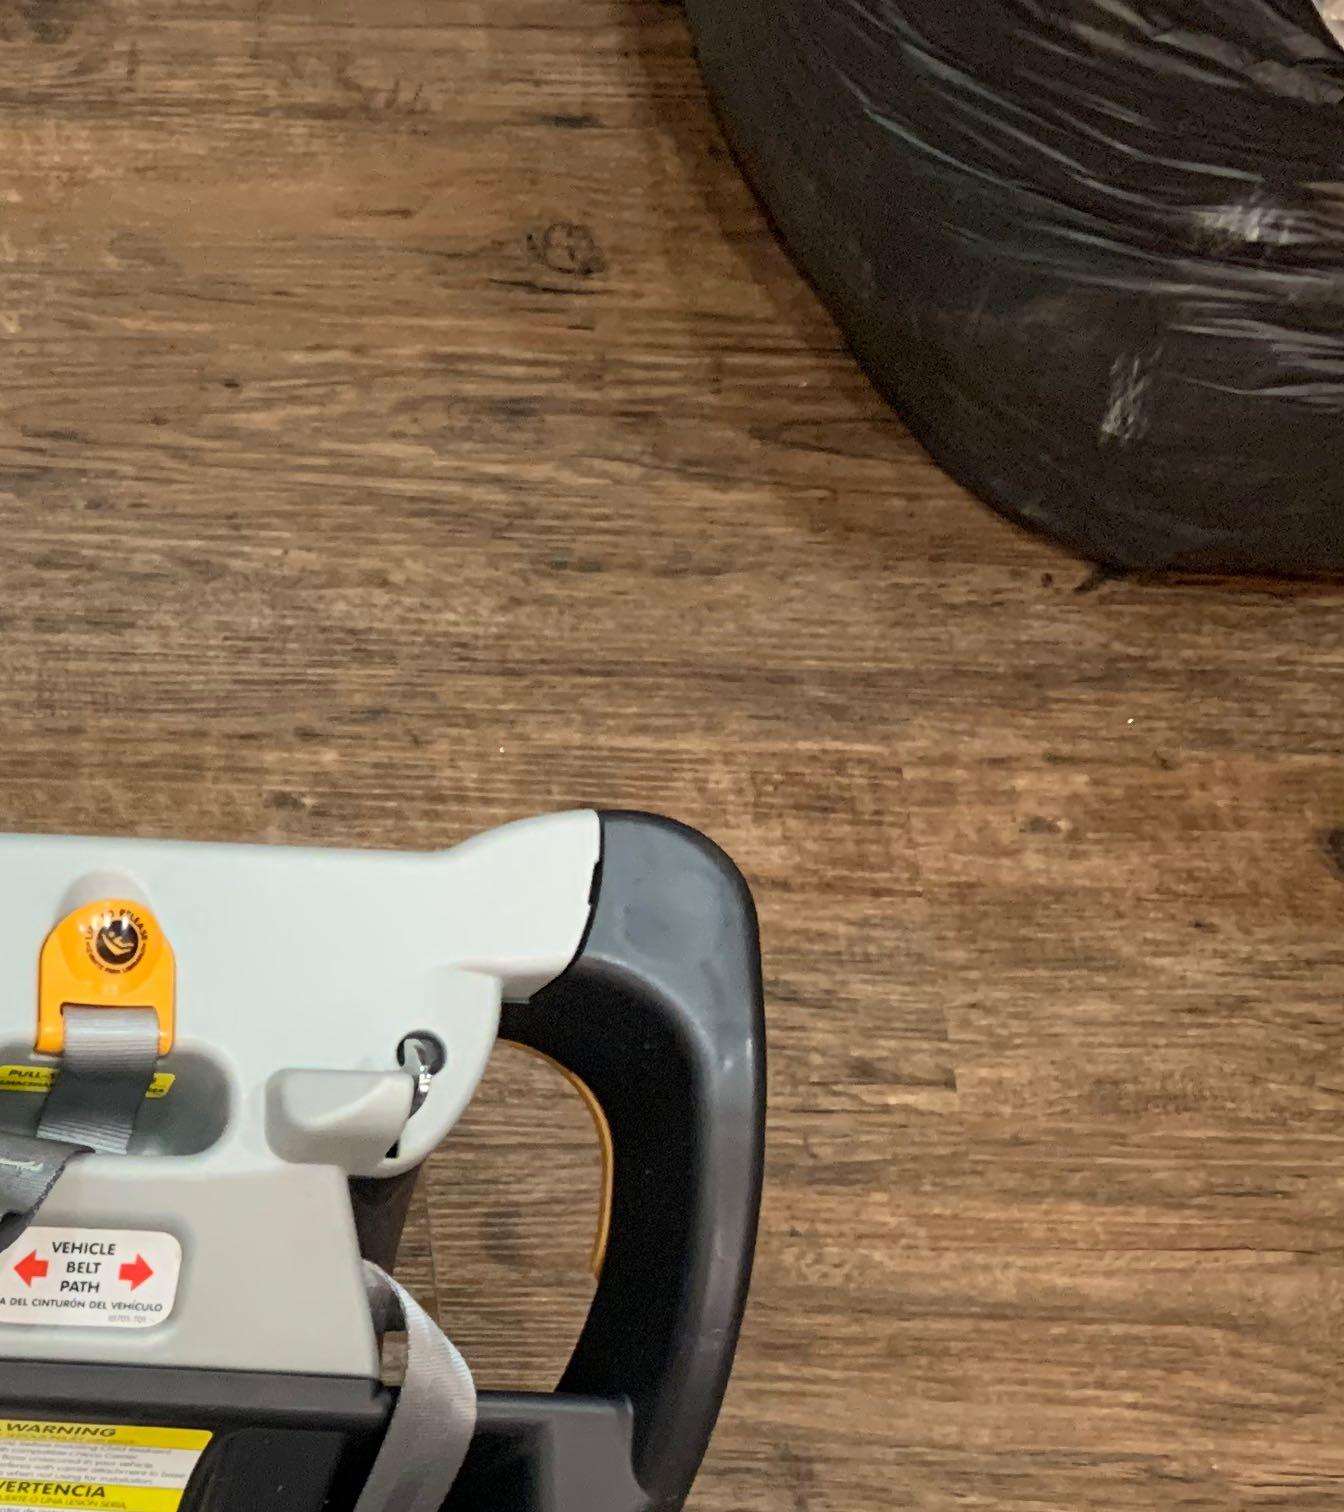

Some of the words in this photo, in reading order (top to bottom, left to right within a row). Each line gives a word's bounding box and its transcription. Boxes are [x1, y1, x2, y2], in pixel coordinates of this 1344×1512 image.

[52, 1241, 116, 1256] VEHICLE
[67, 1262, 101, 1274] BELT
[60, 1281, 100, 1293] PATH
[10, 1298, 28, 1306] DEL
[32, 1298, 85, 1308] CINTURÓN
[89, 1301, 106, 1310] DEL
[112, 1301, 162, 1312] VEHÍCULO
[6, 1422, 116, 1437] WARNING
